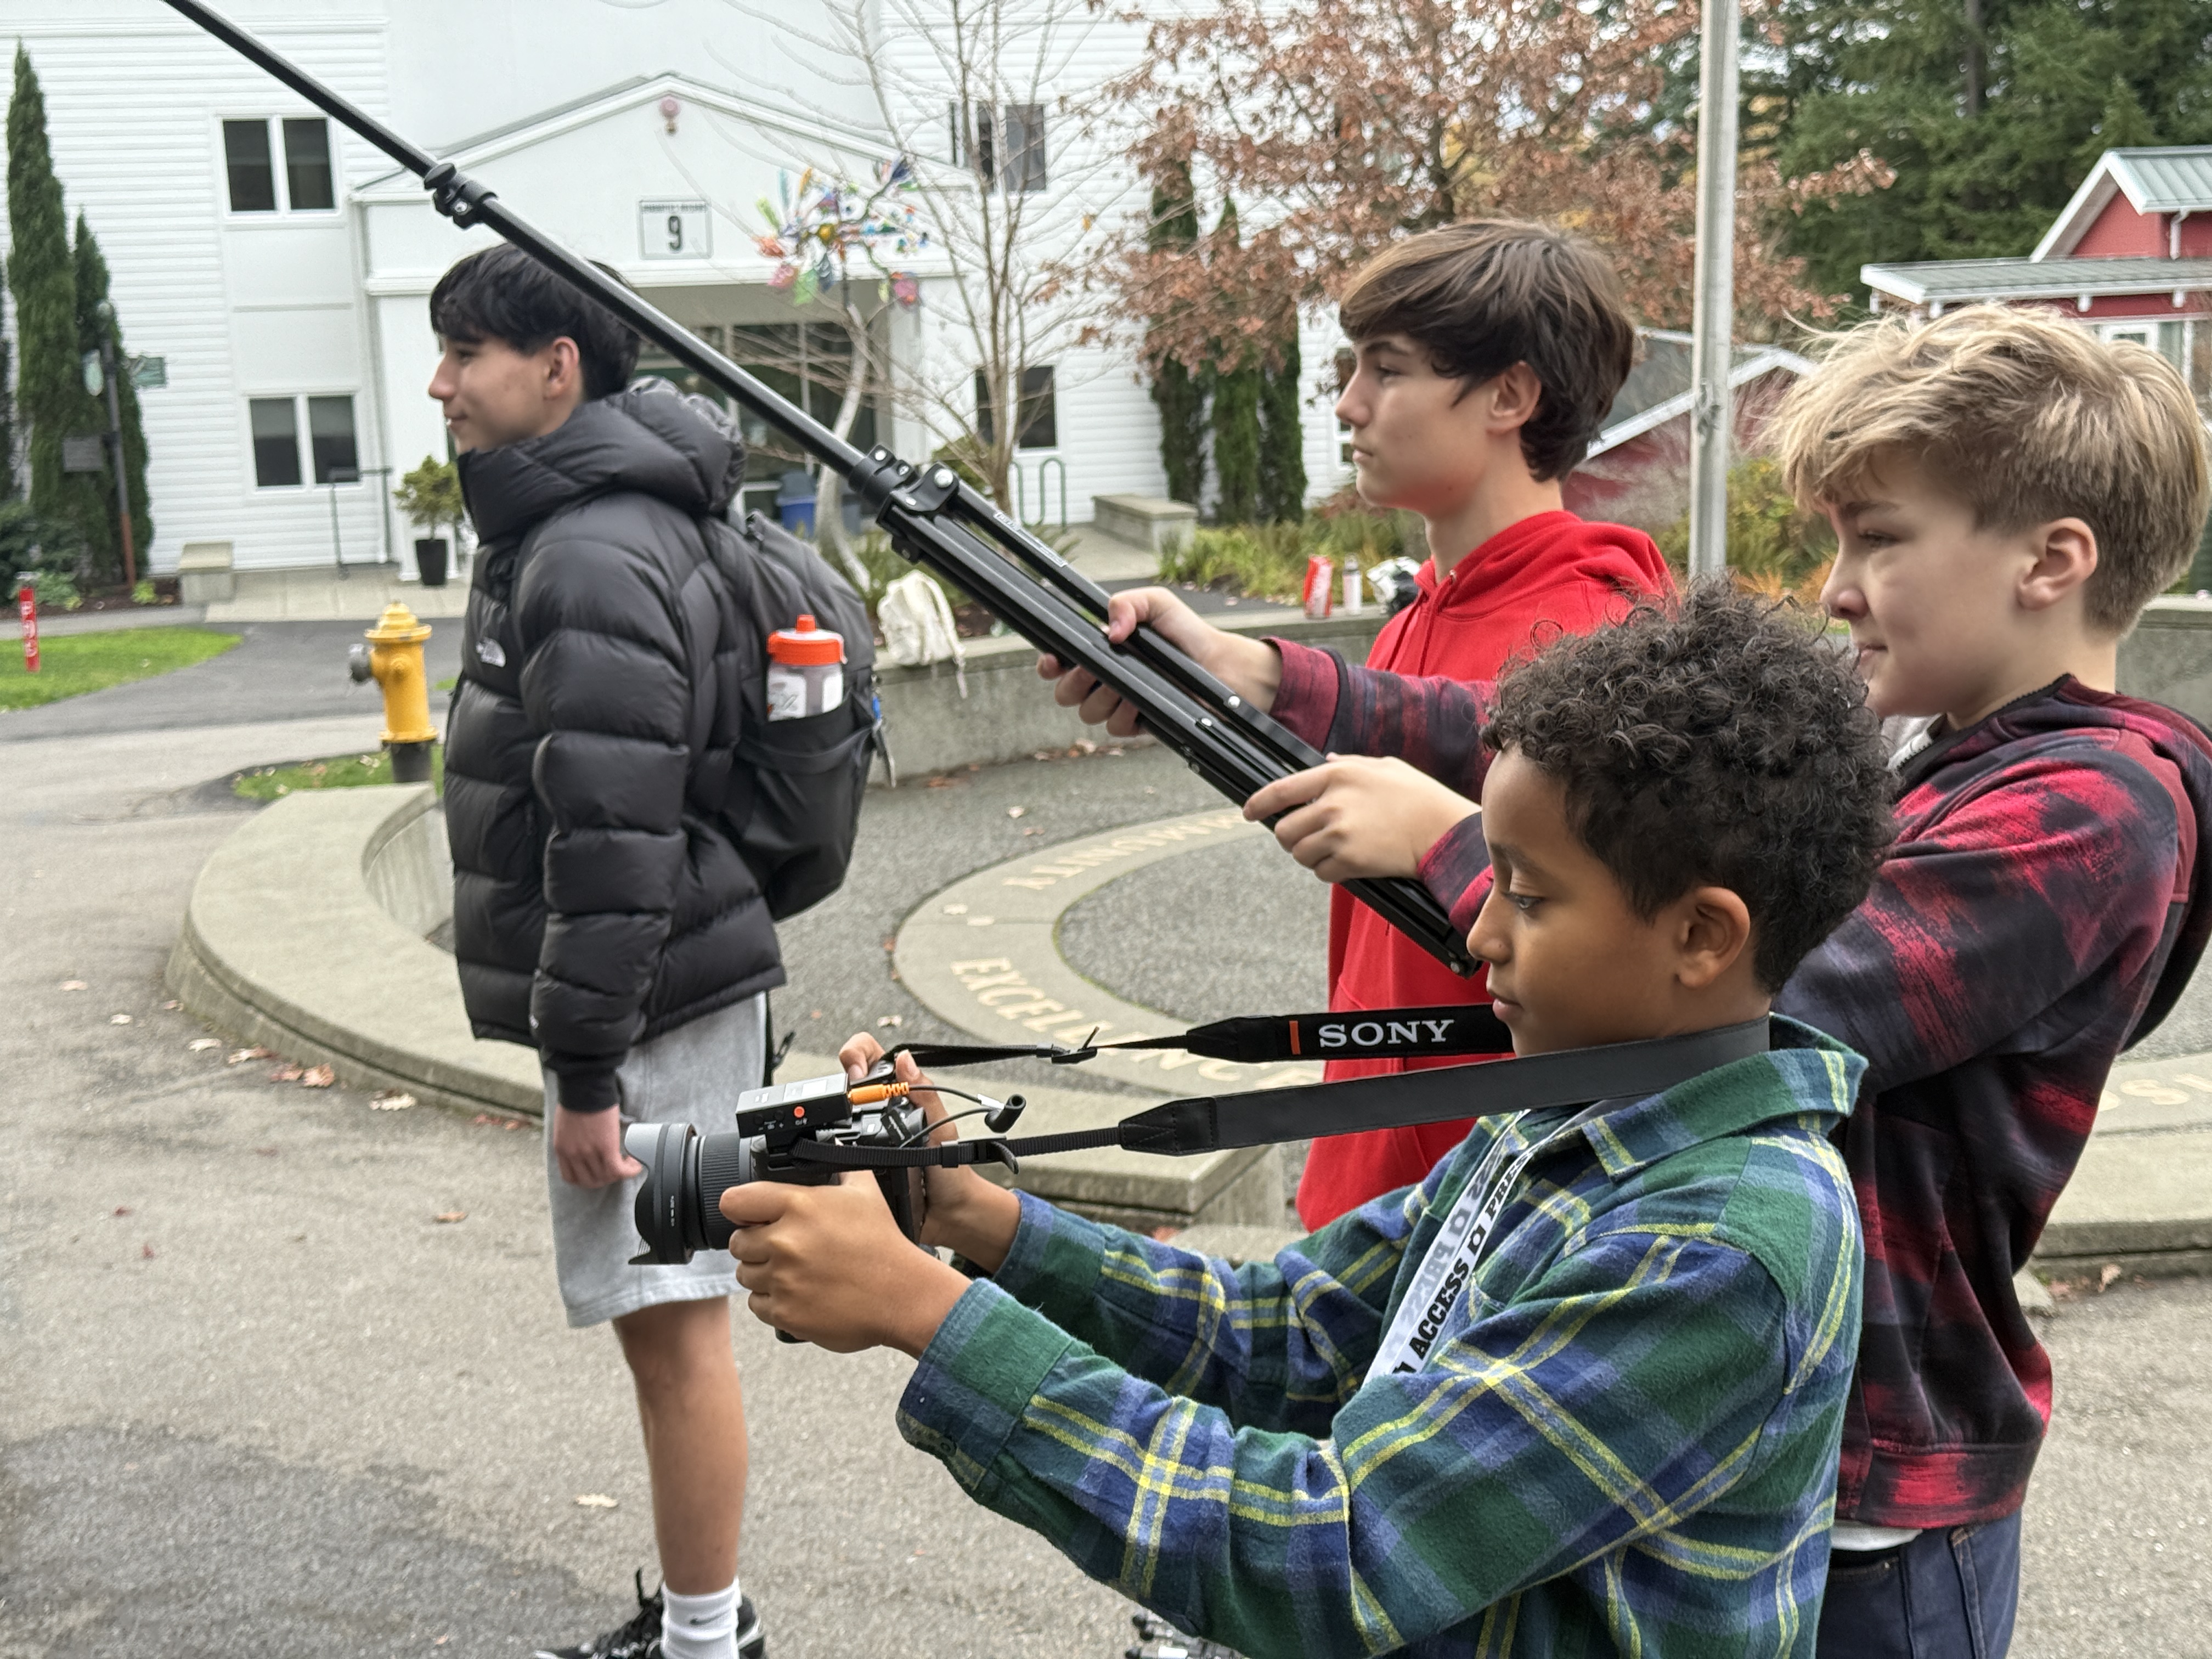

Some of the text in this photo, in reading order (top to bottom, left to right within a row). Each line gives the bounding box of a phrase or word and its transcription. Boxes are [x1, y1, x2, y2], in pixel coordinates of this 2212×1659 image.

[668, 216, 681, 249] 9
[1318, 1019, 1454, 1048] SONY
[1409, 1257, 1469, 1361] ACCESS
